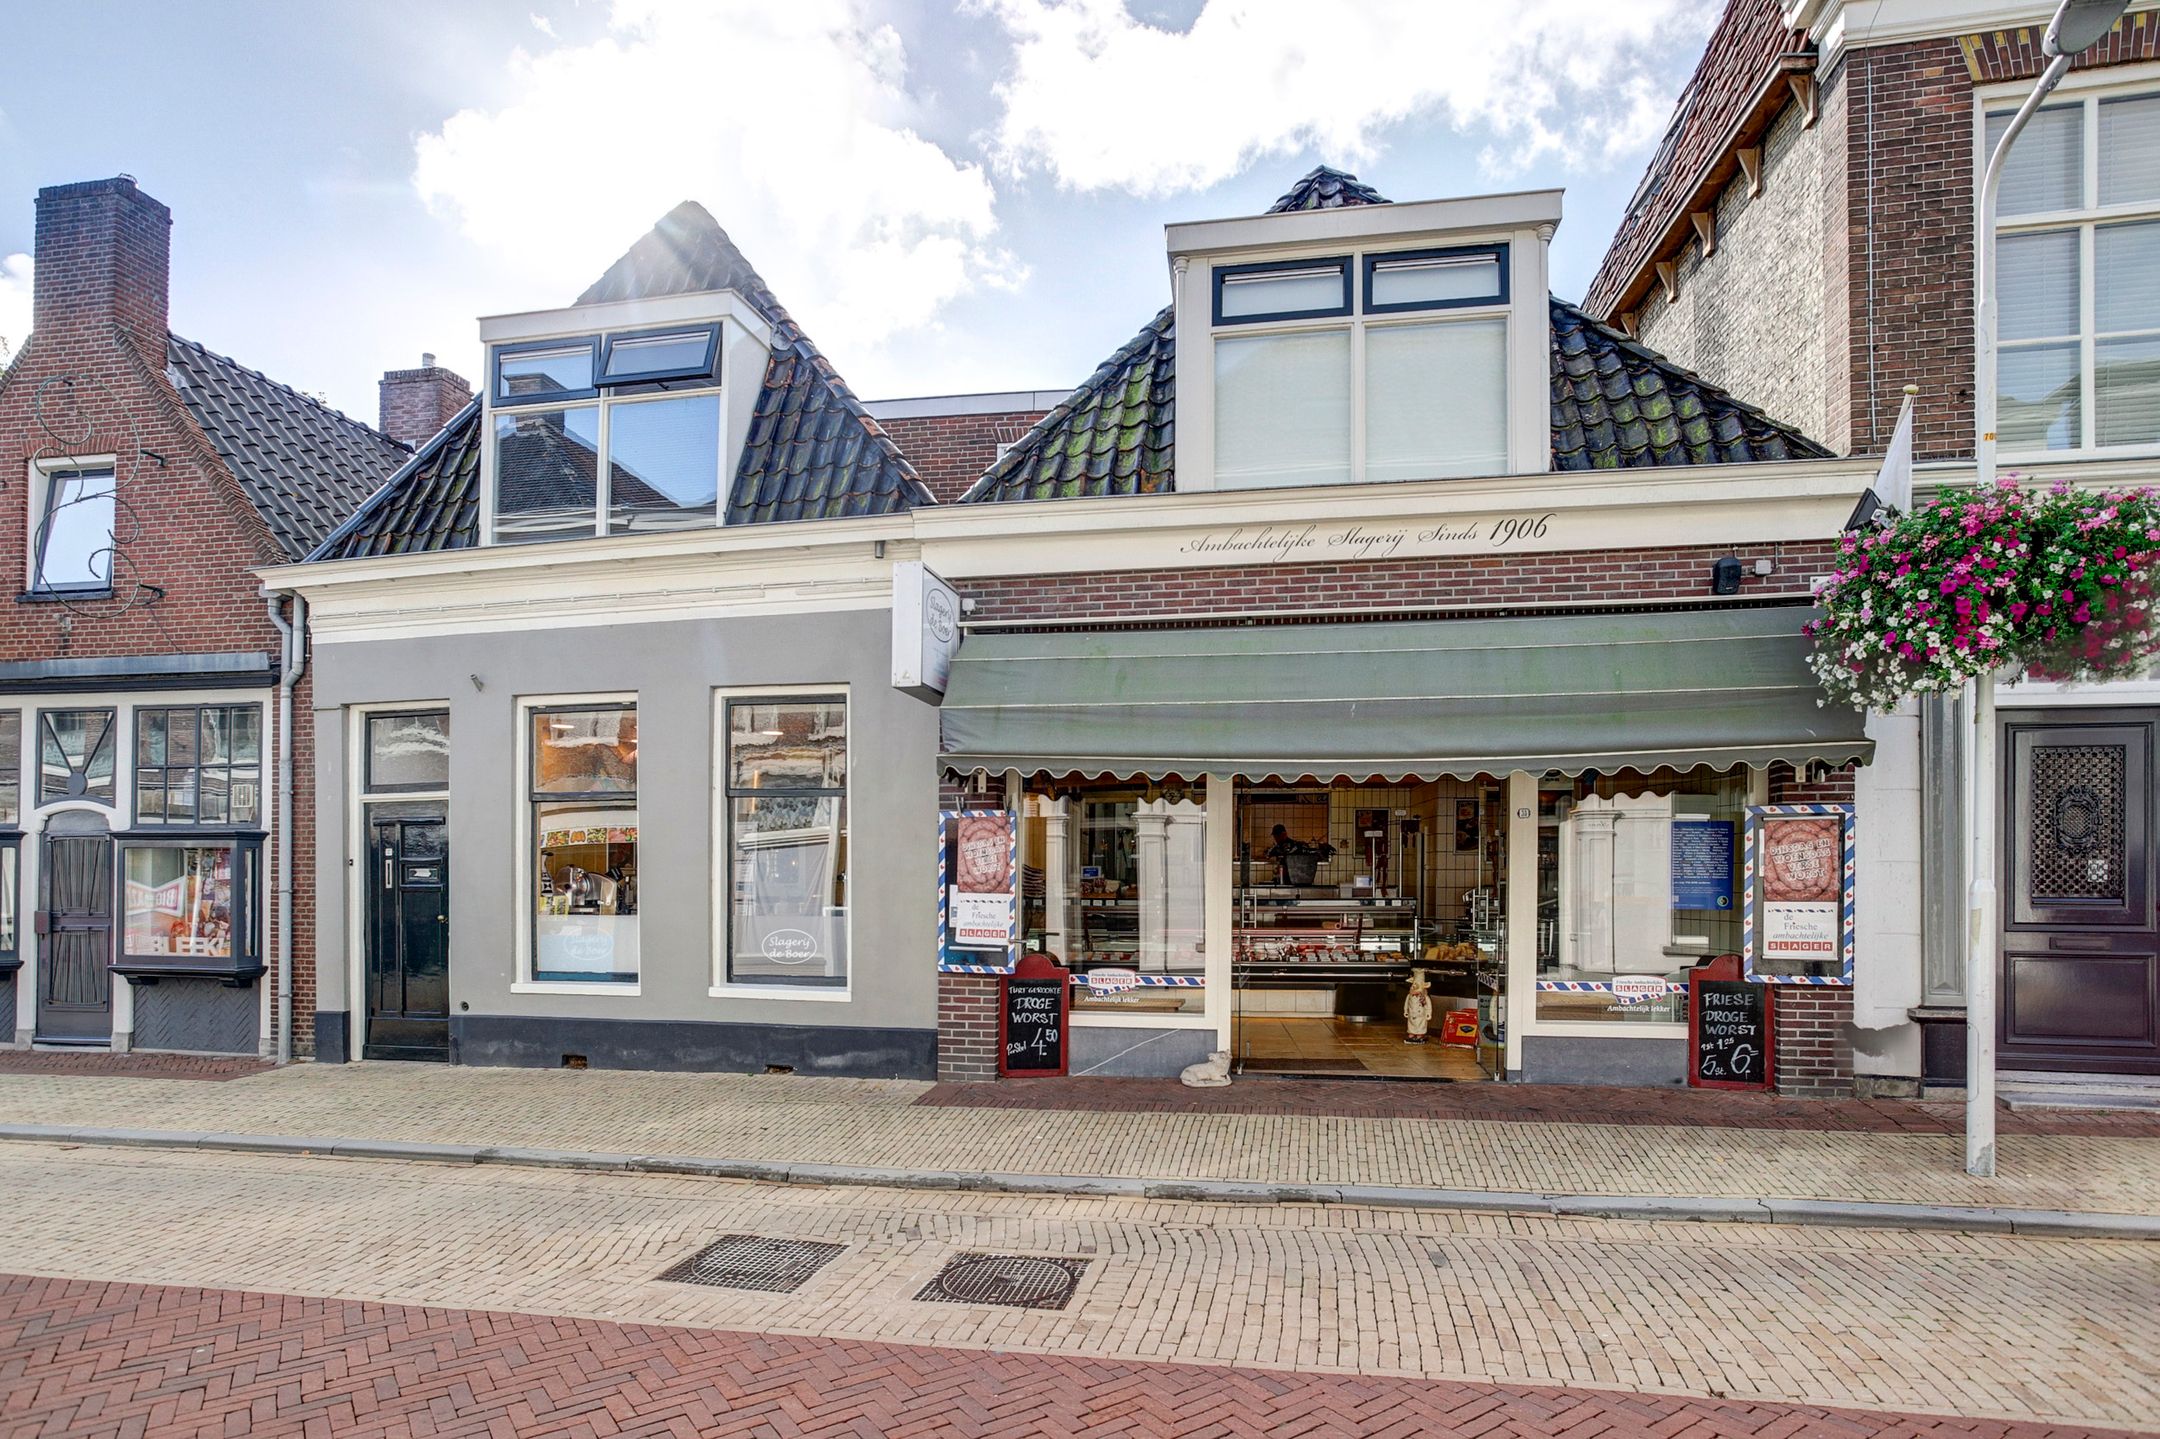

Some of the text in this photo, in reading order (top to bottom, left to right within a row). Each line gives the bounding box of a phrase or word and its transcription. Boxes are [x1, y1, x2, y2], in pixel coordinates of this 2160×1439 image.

[1180, 513, 1557, 563] Ambachtelijke Slagerij Sinds 1906
[1770, 838, 1830, 855] DINSDAG EN
[1773, 848, 1831, 864] WOENSDAG
[1787, 859, 1819, 872] VERSE
[1785, 868, 1825, 881] WORST
[1784, 913, 1794, 921] de
[1784, 922, 1818, 930] Friesche
[960, 929, 1006, 938] SLAGER
[1772, 932, 1829, 940] ambachtelijke
[1768, 942, 1833, 951] SLAGER
[769, 948, 811, 958] de Boer
[1615, 984, 1663, 993] SLAGER
[1013, 996, 1055, 1009] DROGE
[1703, 992, 1754, 1007] FRIESE
[1607, 1005, 1650, 1013] Ambachtelijk
[1011, 1012, 1058, 1025] WORST
[1701, 1010, 1748, 1022] DROGE
[1705, 1024, 1756, 1035] WORST
